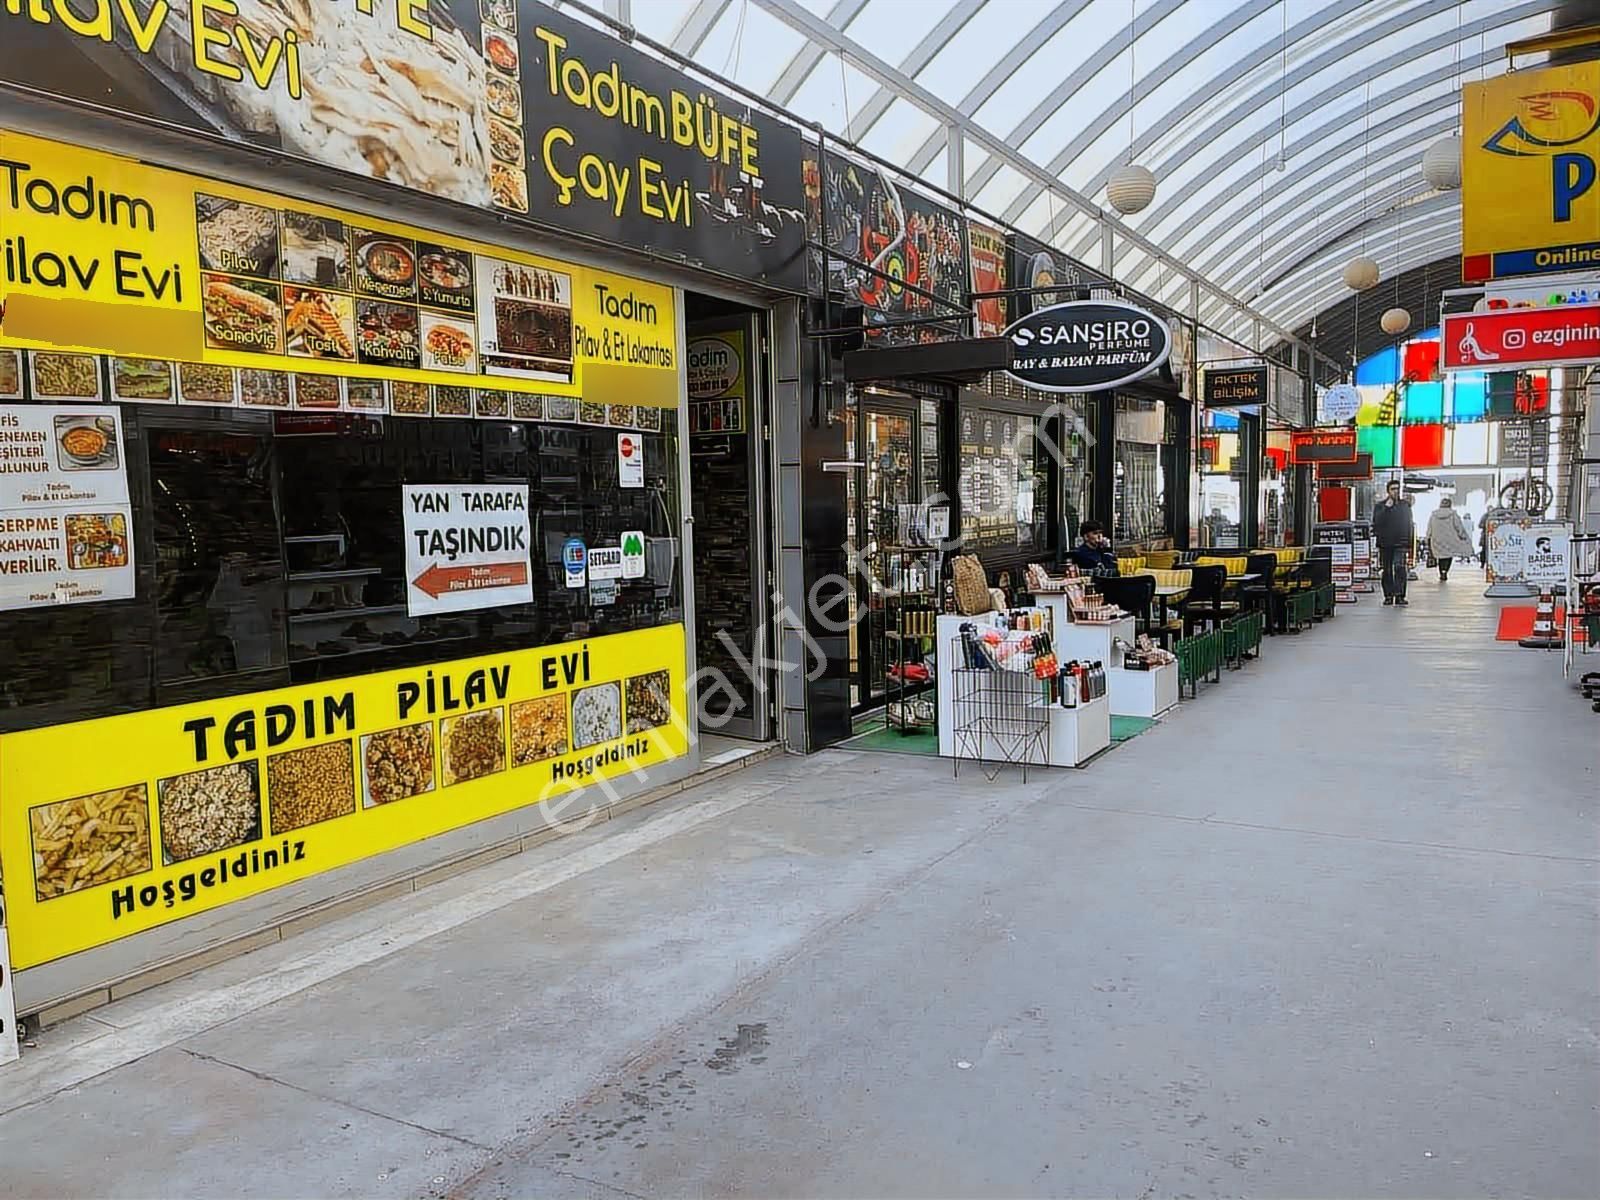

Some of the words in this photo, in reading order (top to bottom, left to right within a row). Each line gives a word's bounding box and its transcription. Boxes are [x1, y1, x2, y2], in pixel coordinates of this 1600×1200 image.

[536, 26, 667, 139] Tadım
[670, 92, 759, 177] BÜFE
[542, 127, 630, 217] Çay
[639, 157, 691, 227] Evi
[0, 158, 155, 232] Tadım
[221, 249, 259, 272] Pilav
[1535, 247, 1600, 267] Online
[114, 249, 182, 302] Evi
[594, 284, 657, 325] Tadım
[308, 336, 337, 352] Tost
[575, 324, 600, 358] Pilav
[603, 327, 612, 360] &
[614, 331, 625, 361] Et
[1013, 358, 1037, 369] BAY
[1038, 358, 1048, 368] &
[1051, 355, 1093, 368] BAYAN
[1096, 350, 1152, 365] PARFÜM
[1089, 339, 1151, 351] PERFUME
[1214, 373, 1257, 385] AKTEK
[411, 492, 449, 513] YAN
[462, 491, 525, 512] TARAFA
[414, 526, 525, 560] TAŞINDIK
[590, 551, 621, 567] SETCARD
[1528, 554, 1563, 563] BARBER
[184, 691, 356, 761] TADIM
[398, 664, 512, 719] PİLAV
[541, 643, 591, 690] EVİ
[553, 738, 649, 783] Hoşgeldiniz
[111, 840, 306, 919] Hoşgeldiniz
